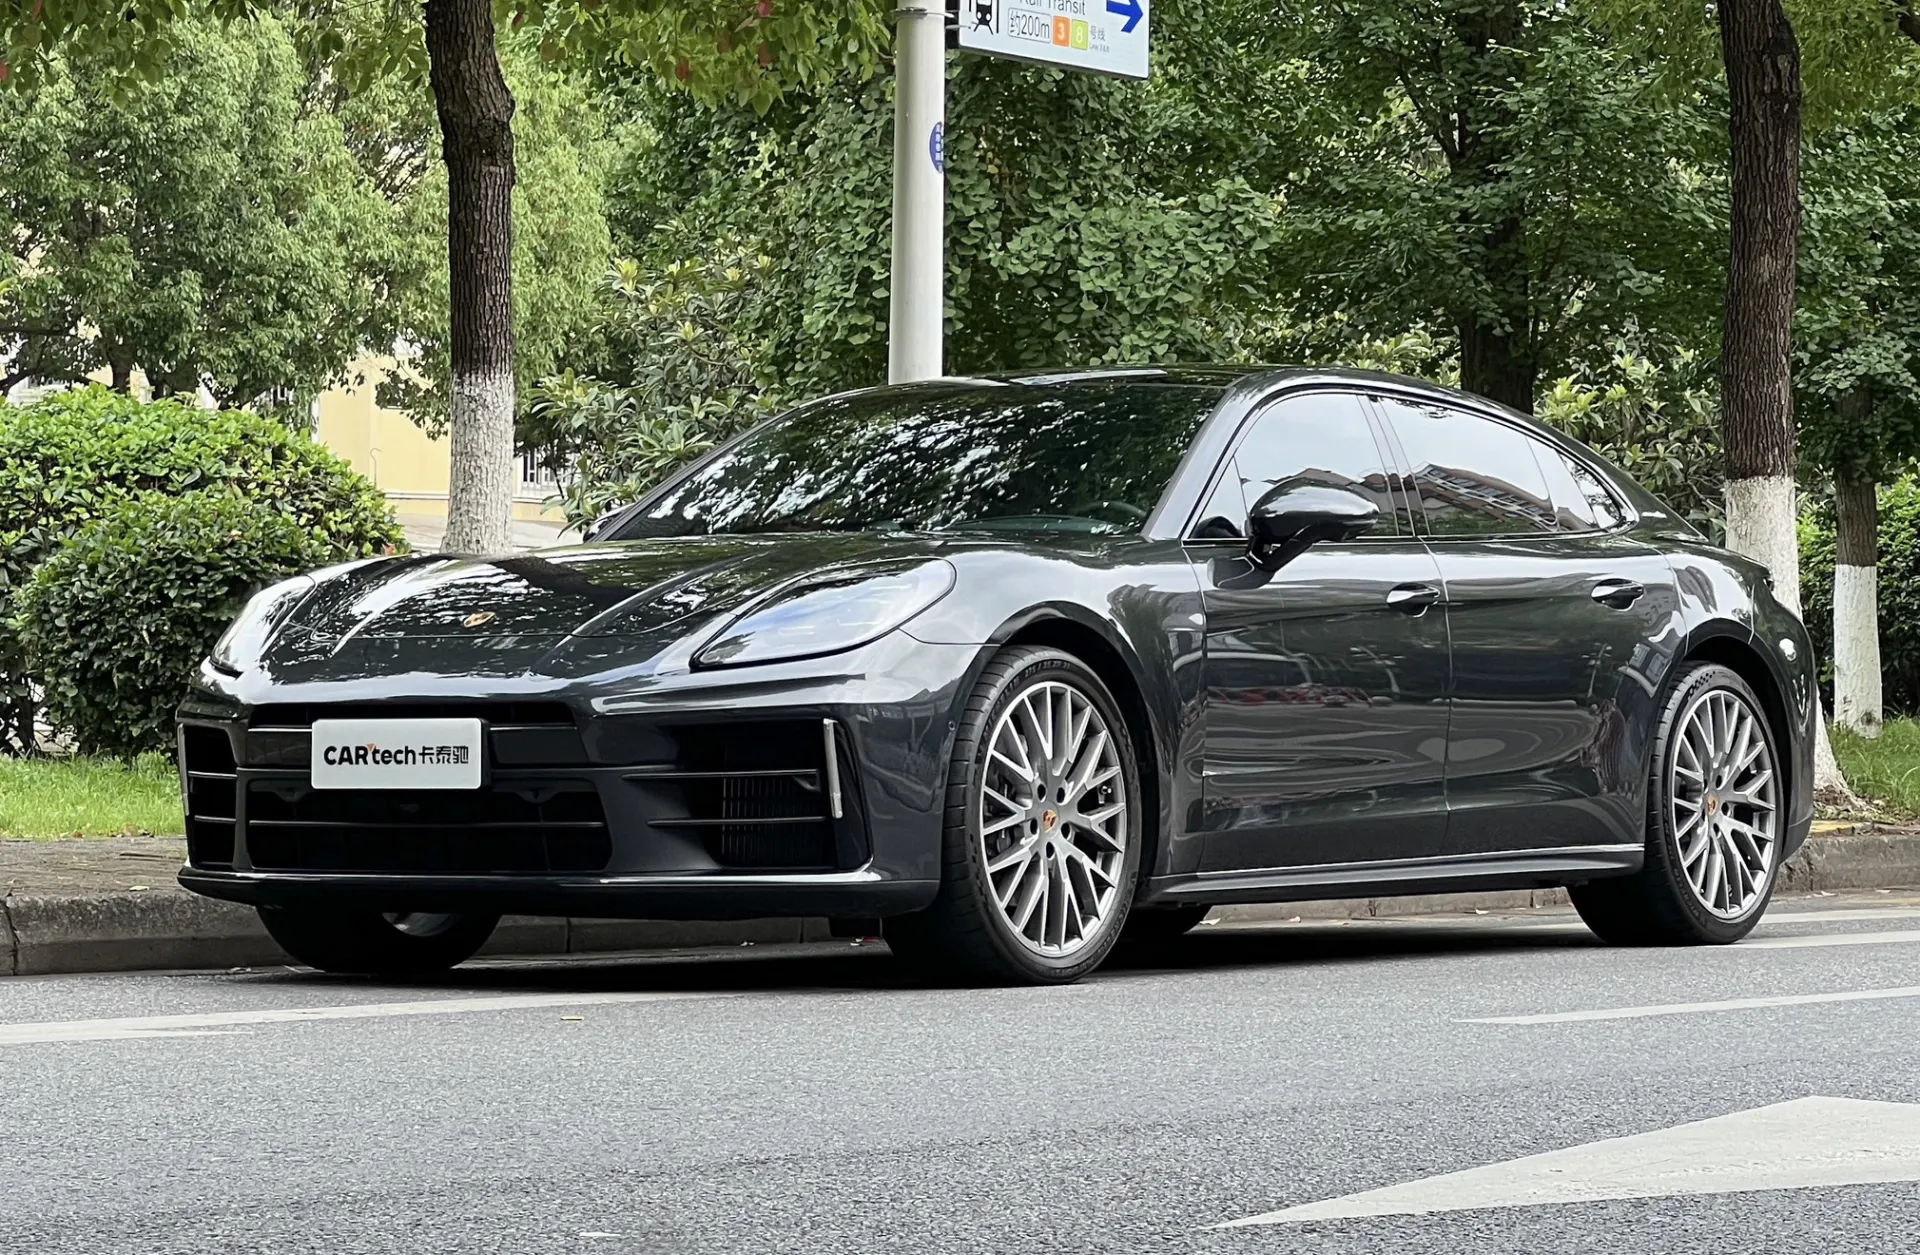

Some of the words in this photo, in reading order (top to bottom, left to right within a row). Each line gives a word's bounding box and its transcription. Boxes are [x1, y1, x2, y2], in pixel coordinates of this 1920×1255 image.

[1057, 23, 1065, 40] 3
[1075, 26, 1083, 43] 8
[323, 744, 416, 766] CARtech
[418, 745, 469, 765] 卡泰驰
